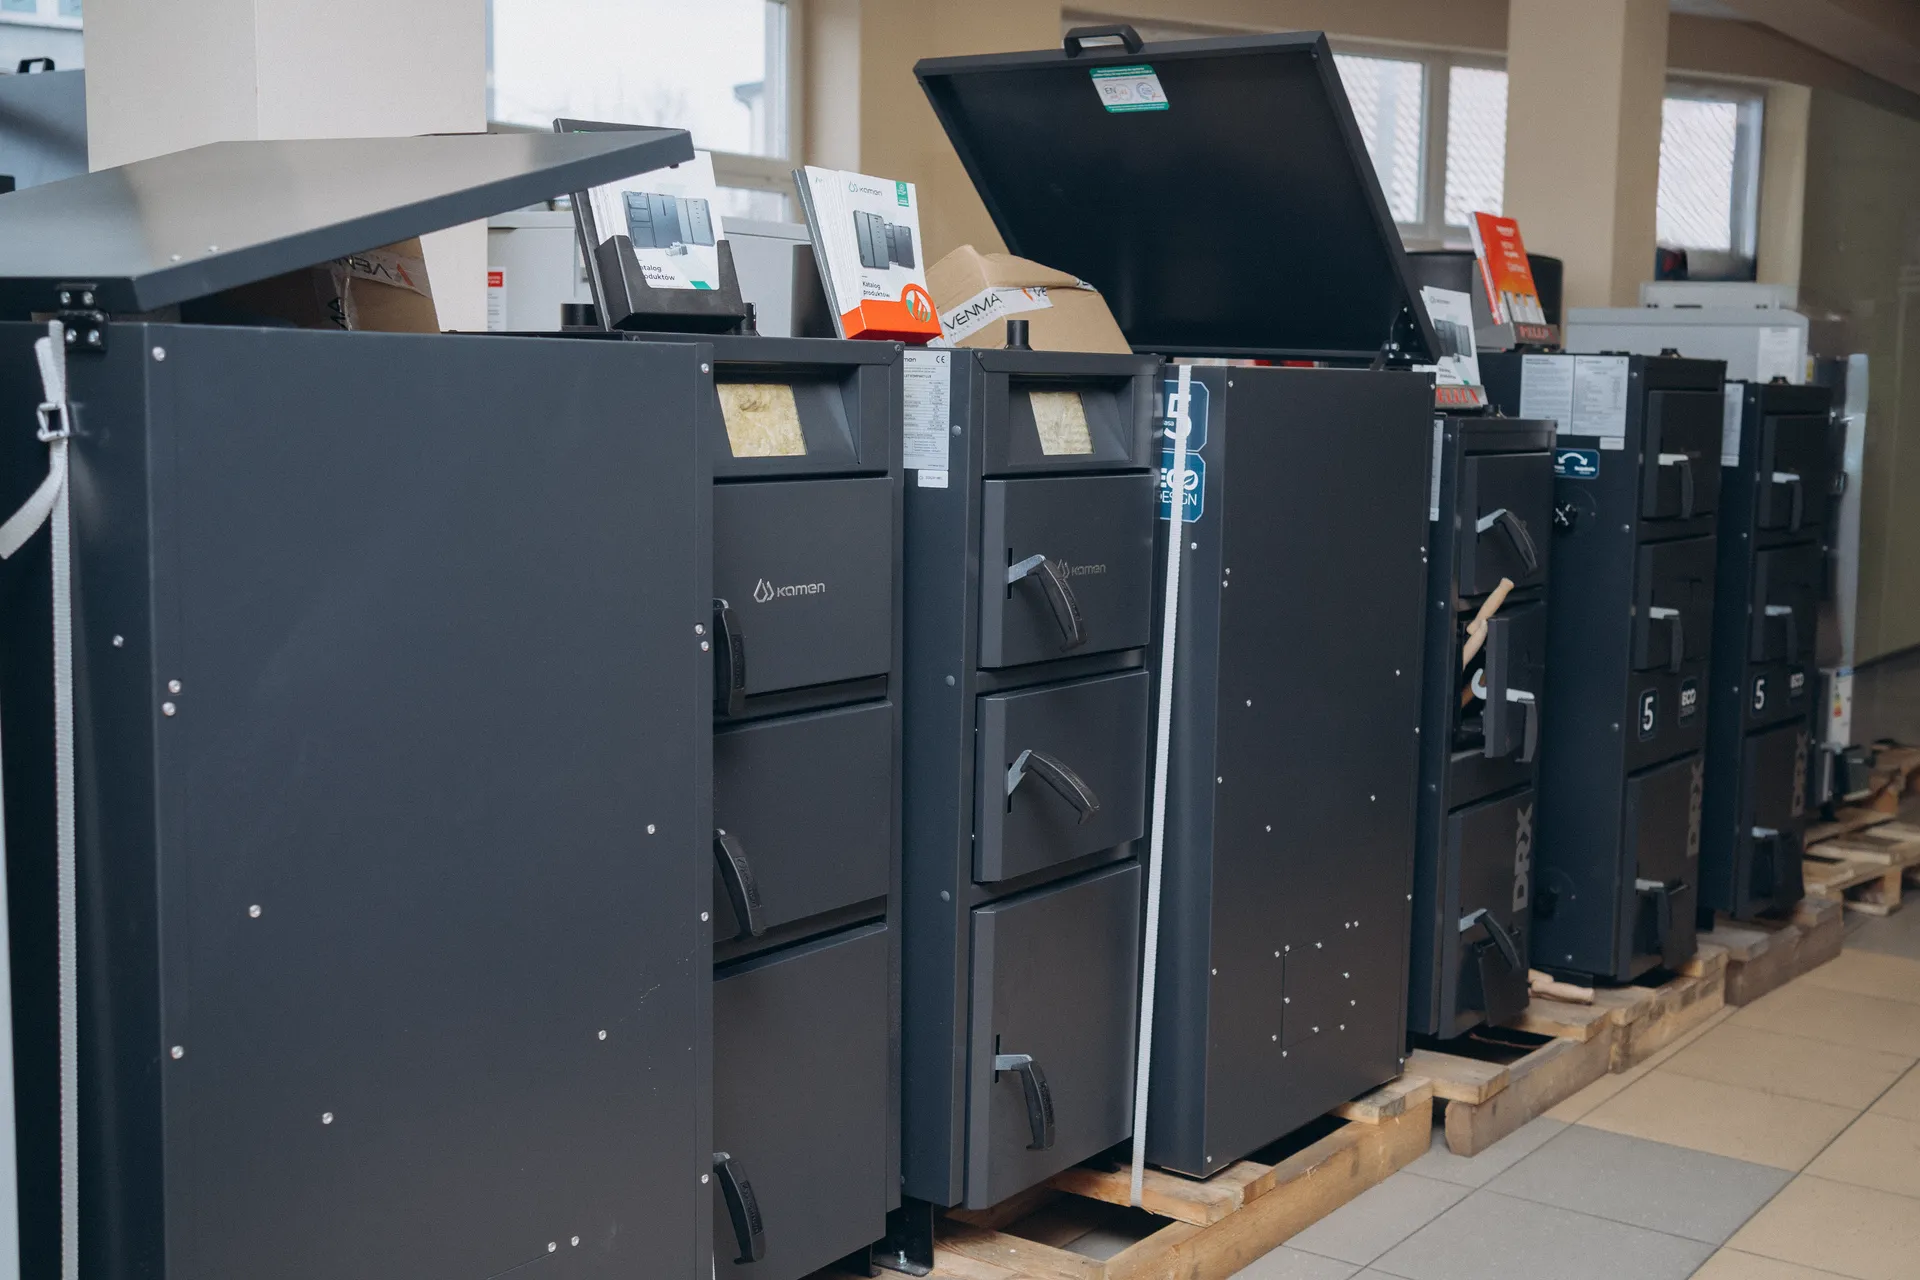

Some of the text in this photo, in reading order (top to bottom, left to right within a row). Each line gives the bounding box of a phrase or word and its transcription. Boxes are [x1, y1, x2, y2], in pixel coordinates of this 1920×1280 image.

[862, 281, 881, 290] Katalog
[943, 293, 1003, 330] VENMA
[1164, 393, 1193, 440] 5
[1071, 563, 1107, 576] kamen
[776, 582, 826, 598] kamen
[1754, 678, 1765, 710] 5
[1642, 695, 1654, 731] 5
[1512, 802, 1533, 912] DRX
